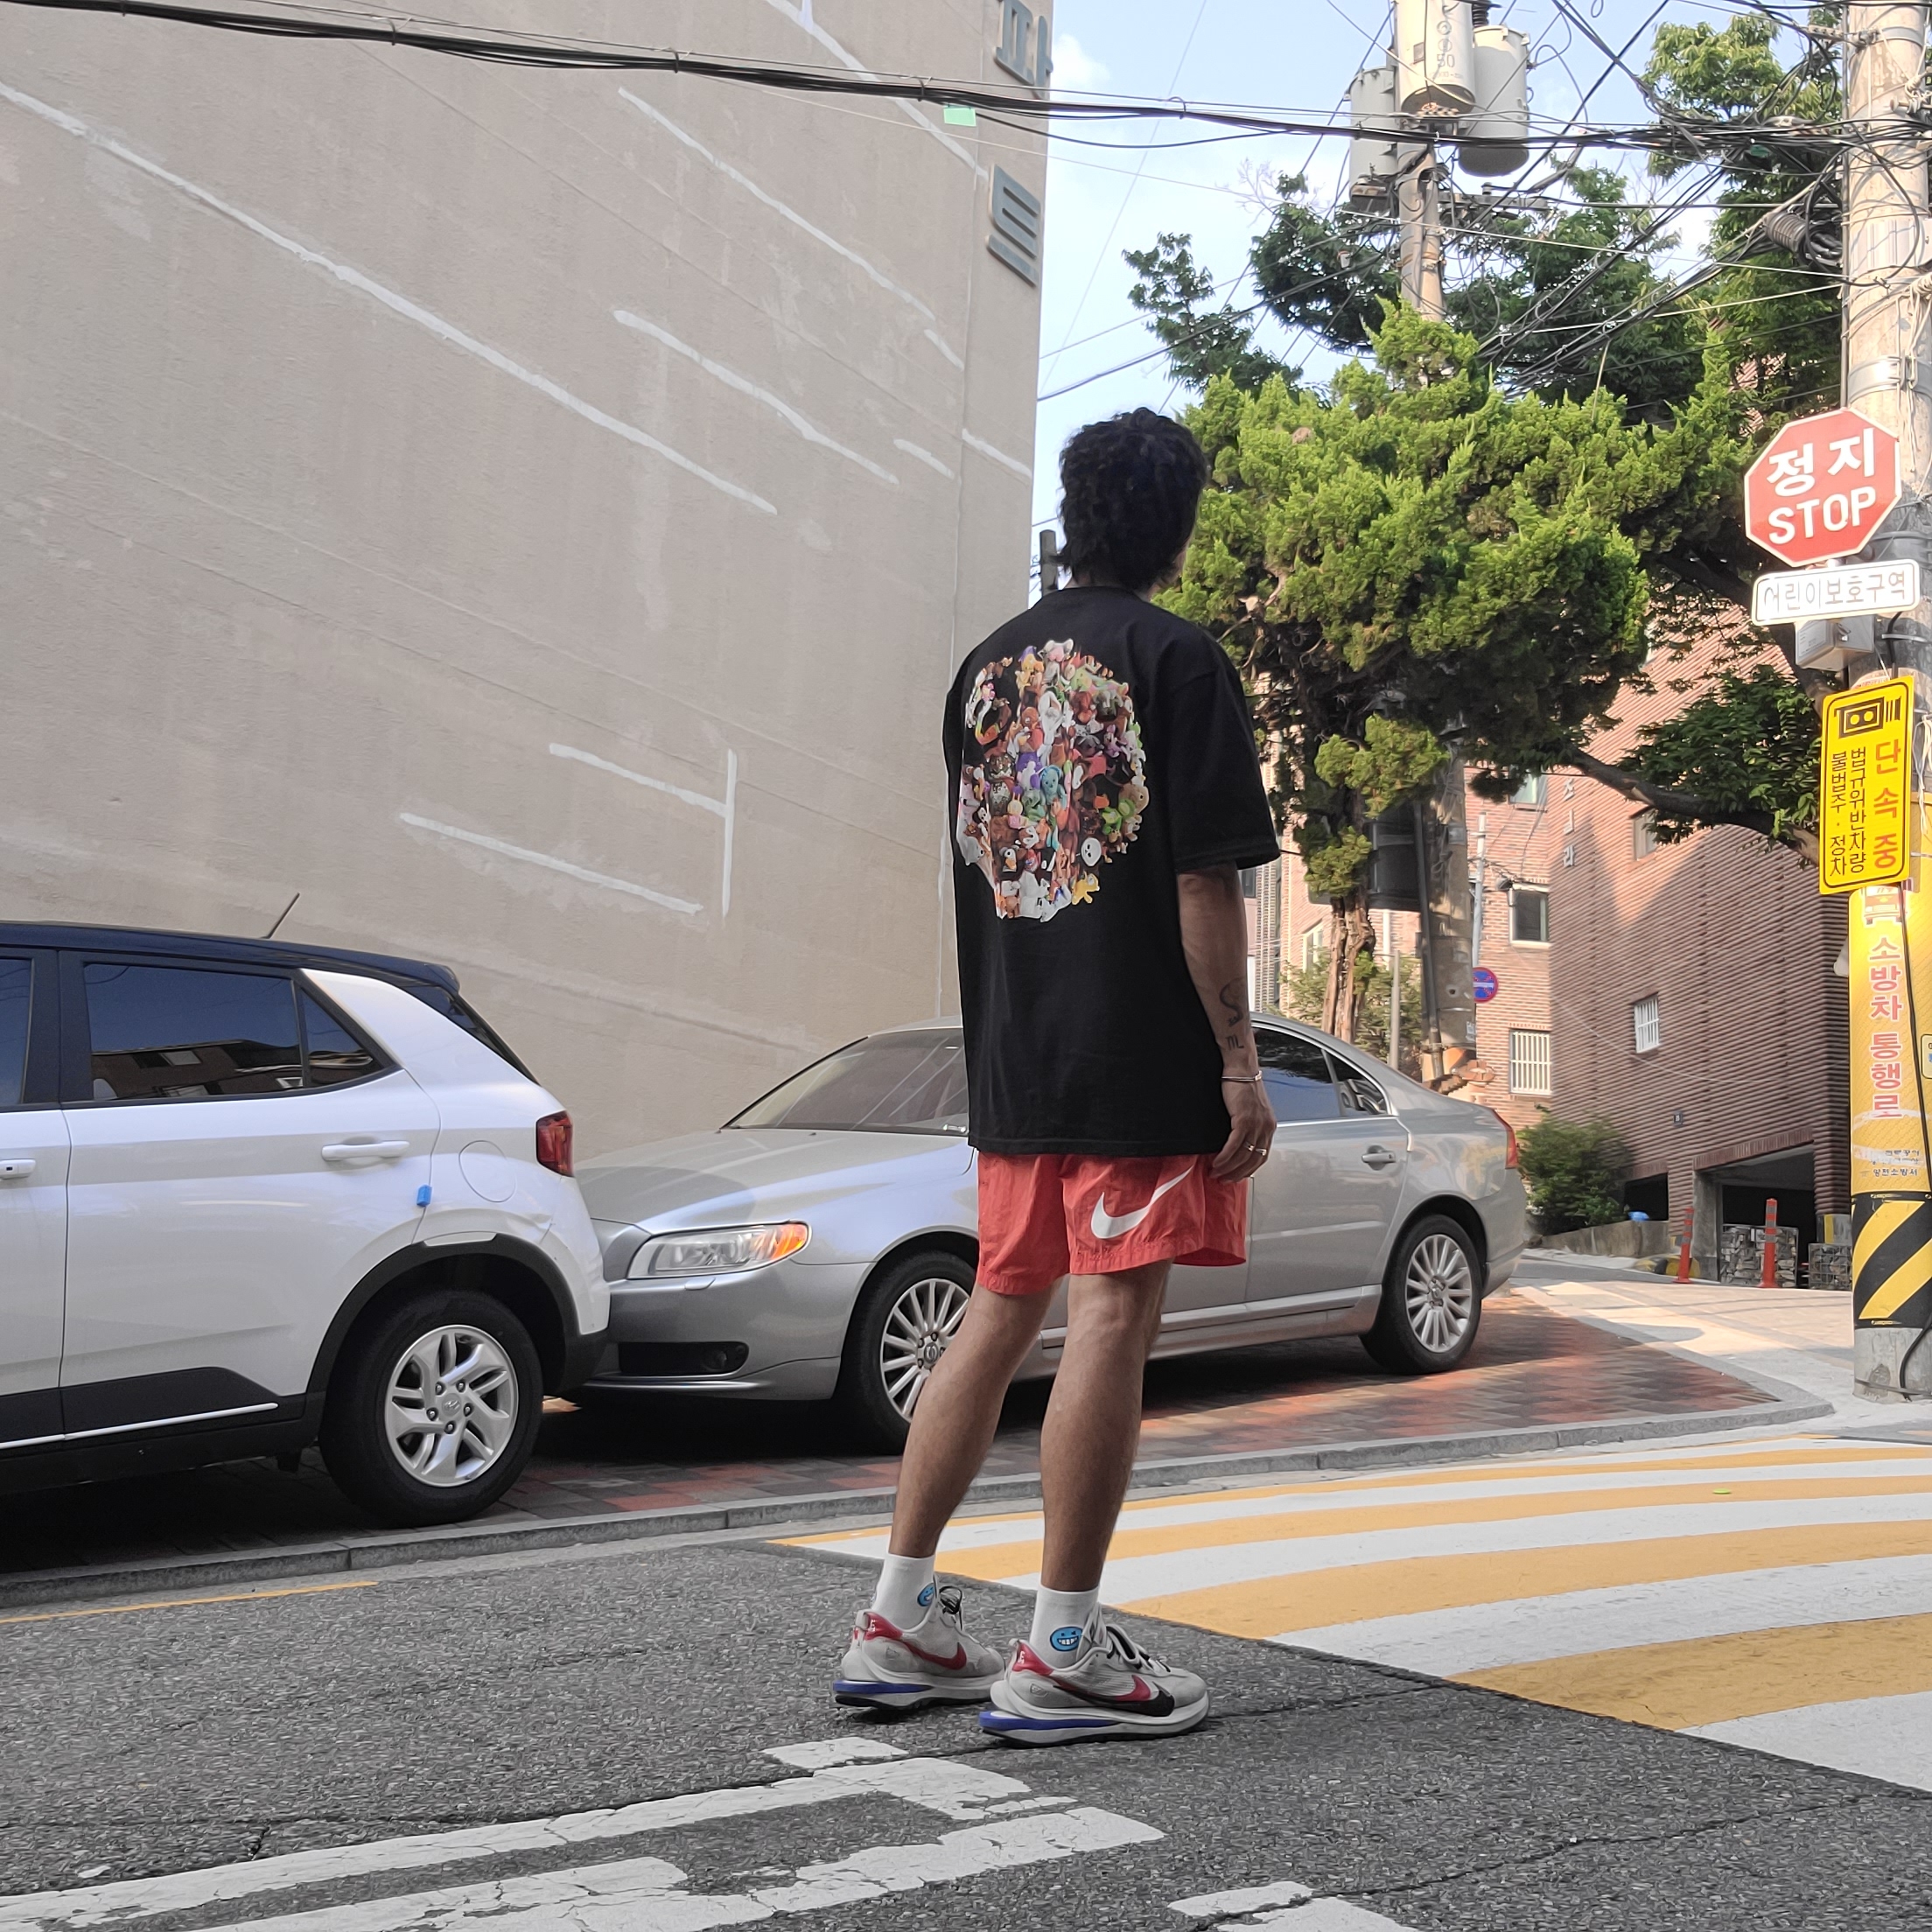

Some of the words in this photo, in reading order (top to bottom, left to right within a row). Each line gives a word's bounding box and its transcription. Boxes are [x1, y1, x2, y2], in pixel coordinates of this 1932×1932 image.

[1766, 427, 1875, 497] 정지
[1768, 486, 1876, 544] STOP
[1763, 570, 1905, 613] 어린이보호구역
[1849, 746, 1866, 873] 법규위반차량
[1872, 738, 1901, 869] 단속중
[1869, 936, 1902, 1022] 소방차
[1870, 1032, 1903, 1118] 통행로
